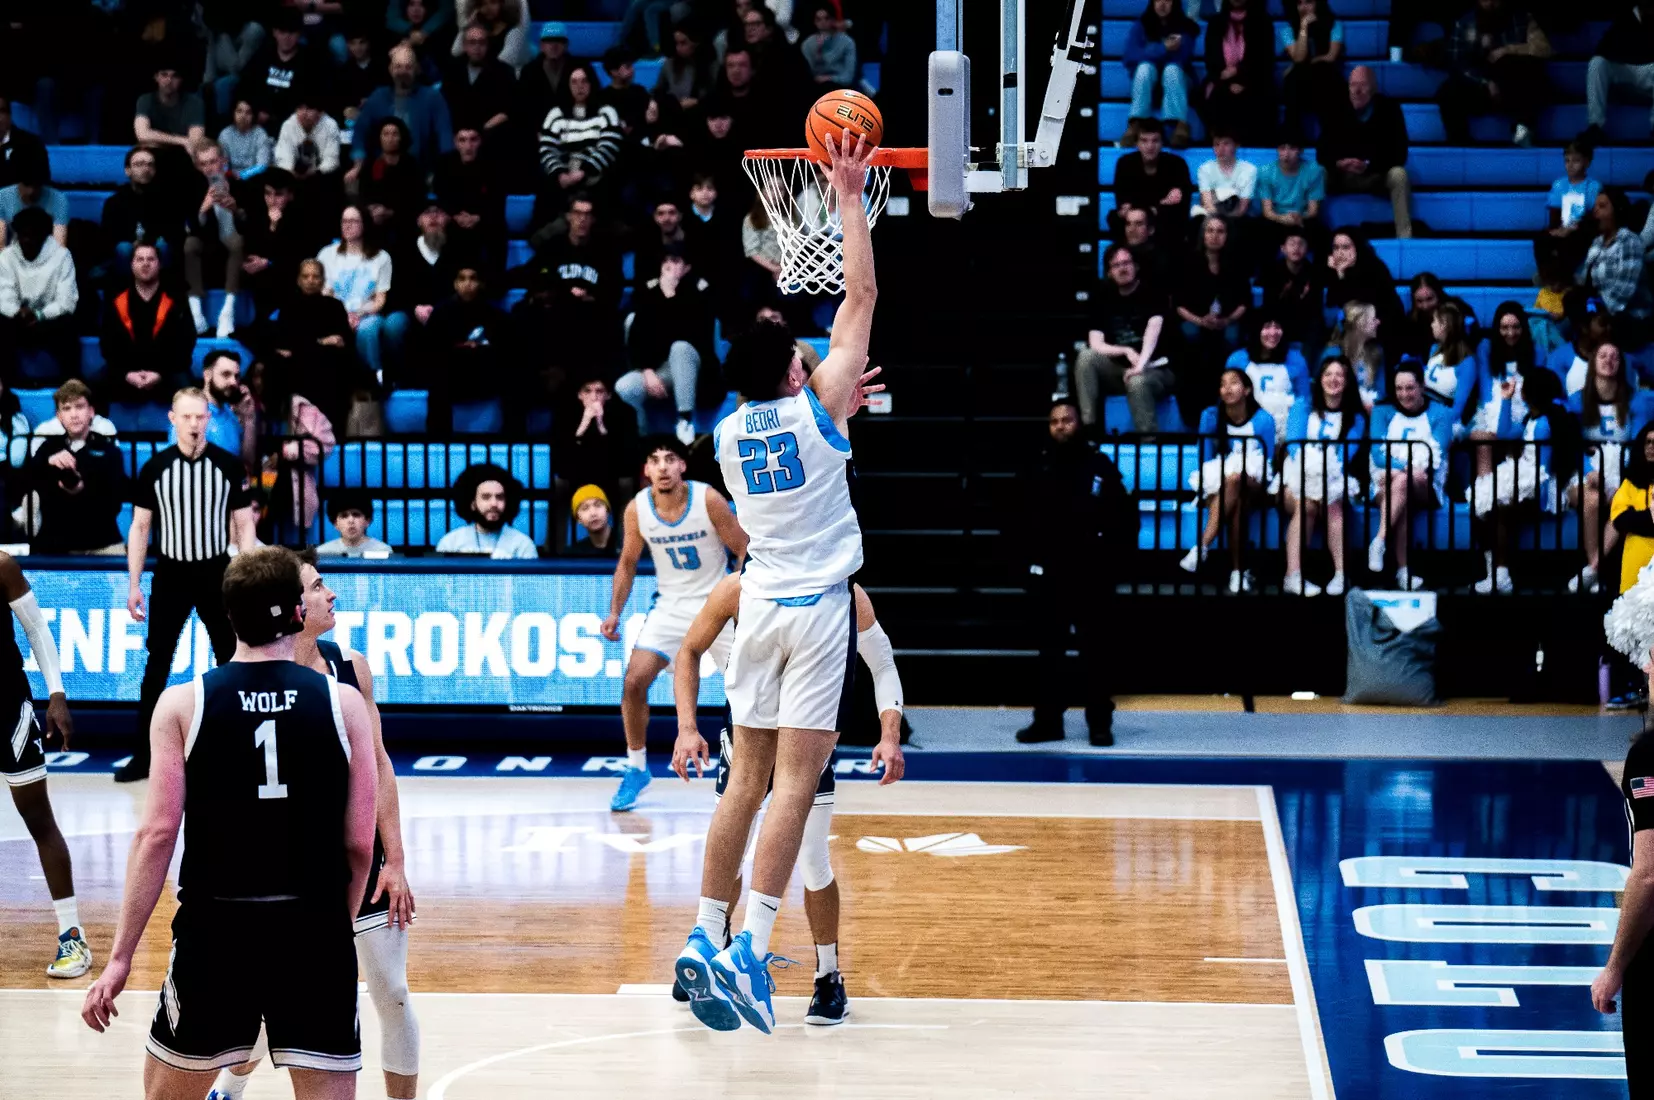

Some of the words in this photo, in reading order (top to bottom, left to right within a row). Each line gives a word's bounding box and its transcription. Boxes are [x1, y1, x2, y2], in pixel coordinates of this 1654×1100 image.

[835, 103, 874, 133] ELITE
[745, 407, 782, 434] BEDRI
[737, 430, 806, 495] 23
[649, 529, 708, 545] COLUMBIA
[665, 545, 702, 571] 13
[238, 688, 299, 713] WOLF
[34, 737, 45, 755] Y
[254, 719, 289, 800] 1
